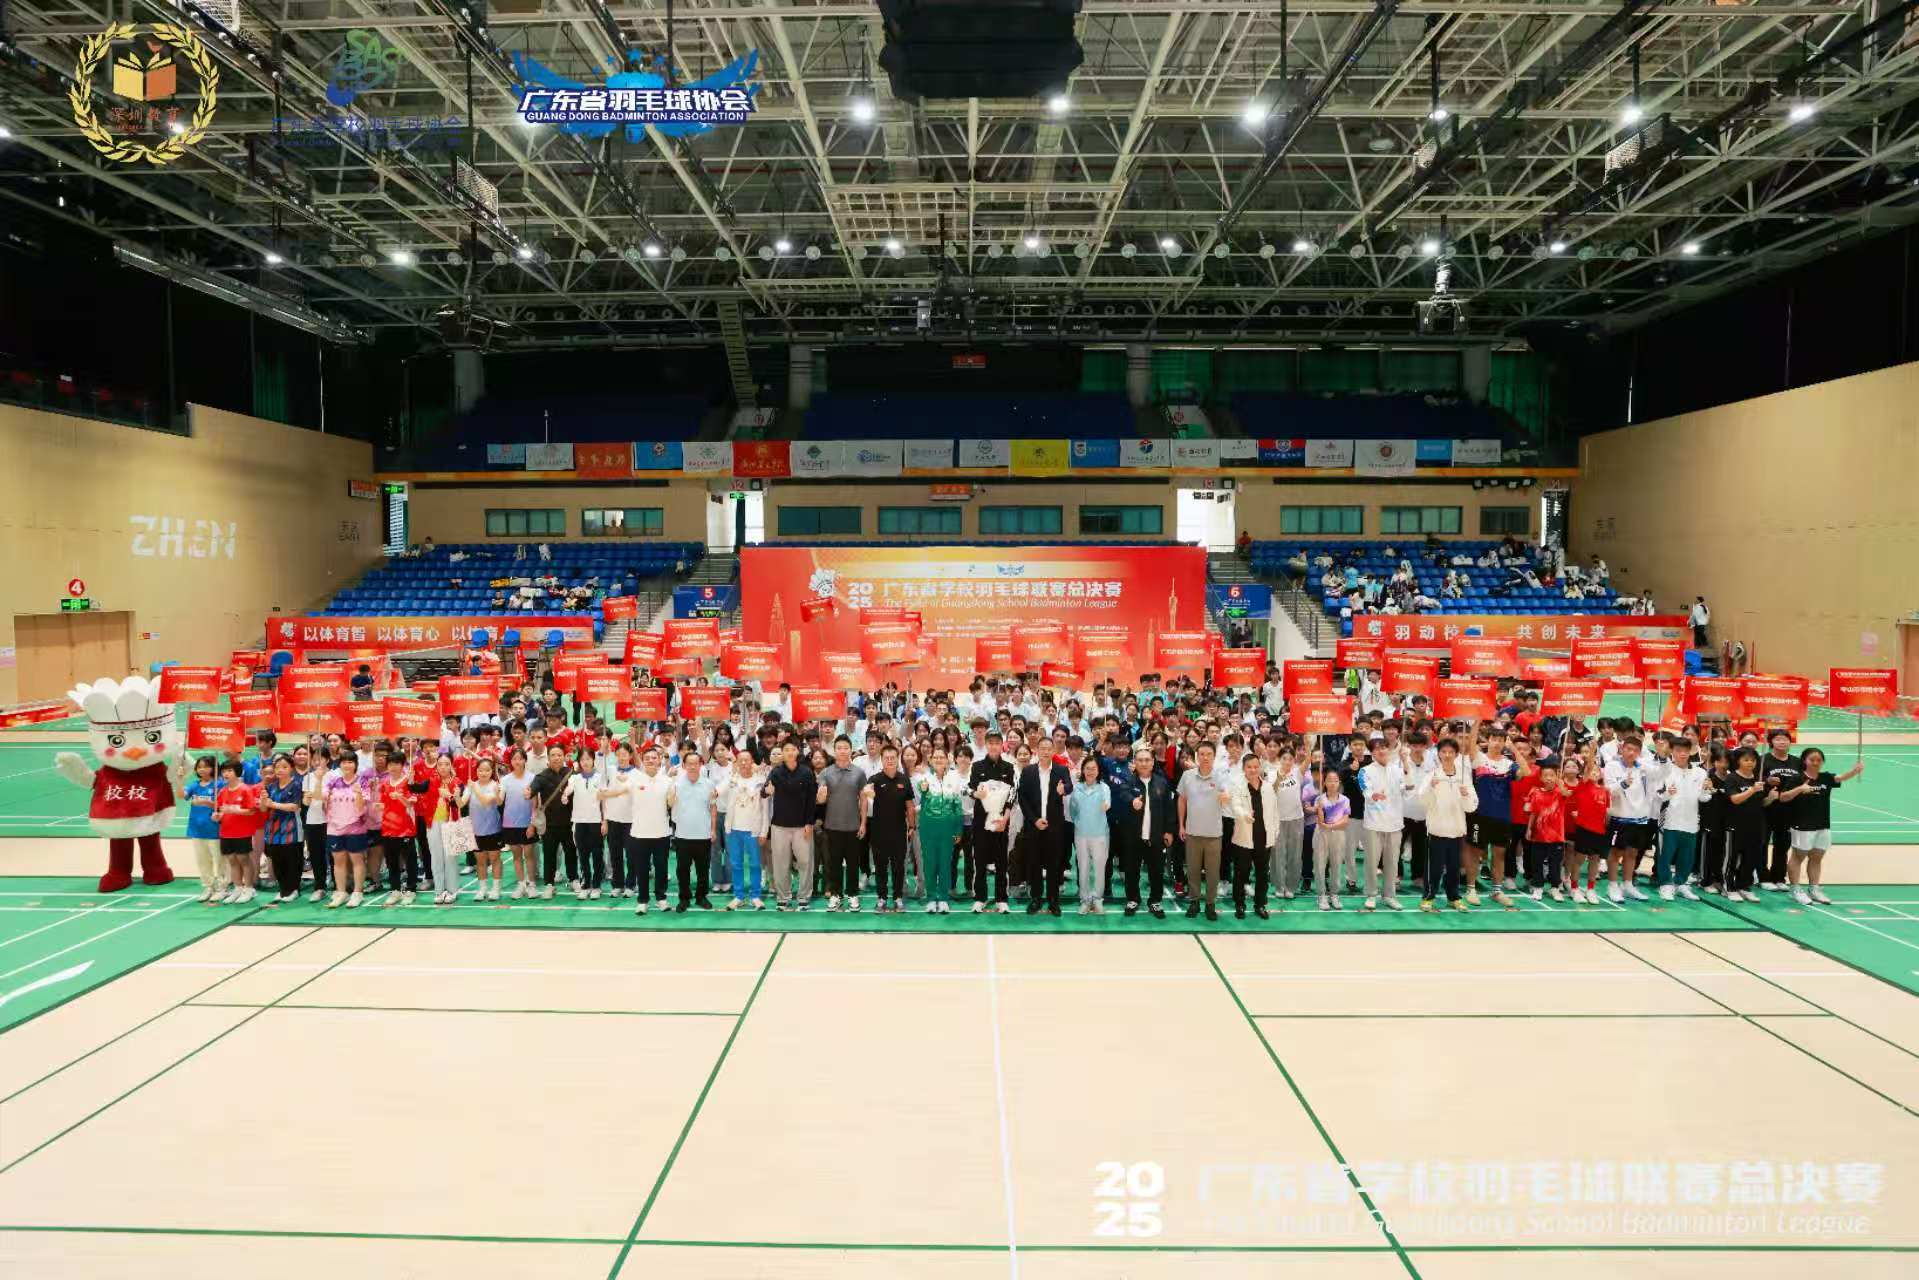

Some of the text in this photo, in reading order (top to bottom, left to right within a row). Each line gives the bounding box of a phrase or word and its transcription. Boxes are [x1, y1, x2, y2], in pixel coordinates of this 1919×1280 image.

[71, 581, 82, 594] 4
[704, 587, 714, 599] 5
[848, 582, 873, 595] 20
[1230, 586, 1240, 598] 6
[848, 596, 872, 608] 25
[303, 625, 508, 642] 以体育智 以体育心 以育
[1517, 624, 1606, 640] 共创未来
[104, 785, 149, 801] 校校
